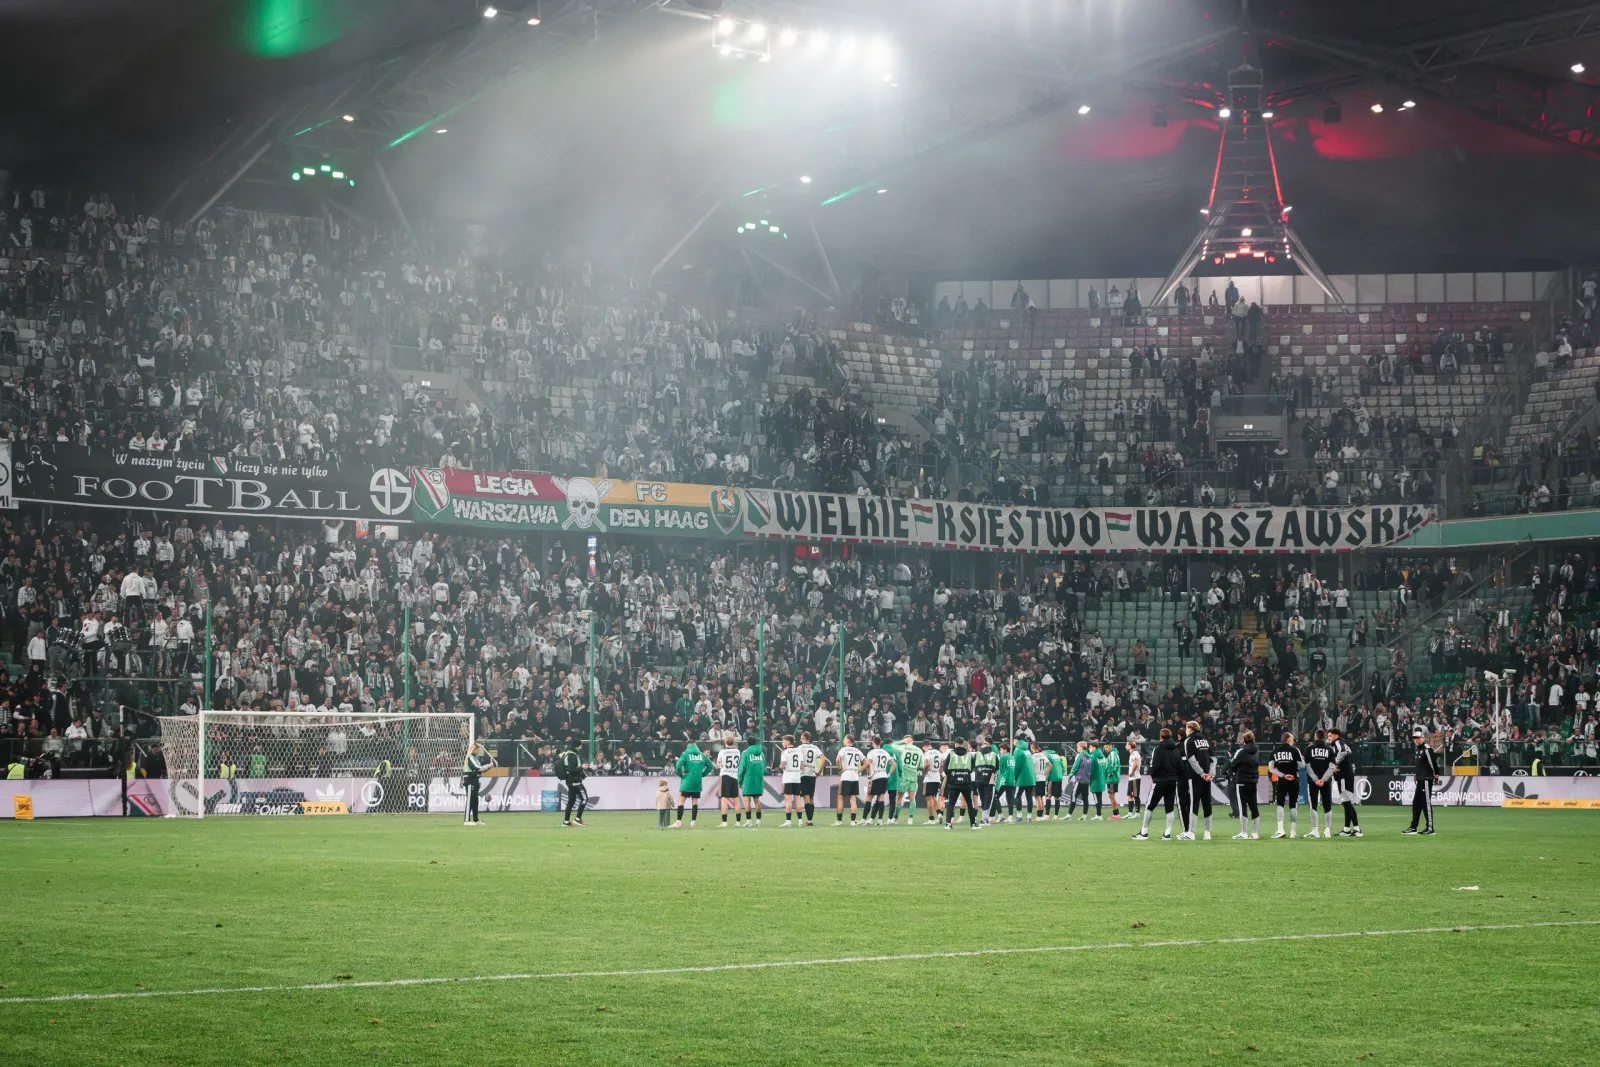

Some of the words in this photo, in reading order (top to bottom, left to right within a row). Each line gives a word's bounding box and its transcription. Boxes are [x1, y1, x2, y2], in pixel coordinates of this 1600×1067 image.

[115, 453, 129, 465] W
[131, 457, 173, 470] naszym
[177, 457, 205, 472] życiu
[235, 460, 260, 475] liczy
[264, 463, 278, 477] się
[282, 465, 298, 476] nie
[301, 464, 328, 479] tylko
[473, 474, 539, 497] LEGIA
[636, 483, 667, 502] FC
[452, 498, 559, 525] WARSZAWA
[773, 491, 910, 539] WIELKIE
[609, 508, 650, 528] DEN
[654, 509, 709, 530] HAAG
[806, 749, 814, 764] 9
[847, 753, 860, 767] 79
[904, 752, 919, 766] 89
[1274, 751, 1294, 762] LEGIA
[1311, 748, 1329, 759] LEGIA
[725, 755, 739, 769] 53
[792, 754, 799, 768] 6
[877, 755, 887, 769] 13
[1438, 792, 1480, 802] BARWACH
